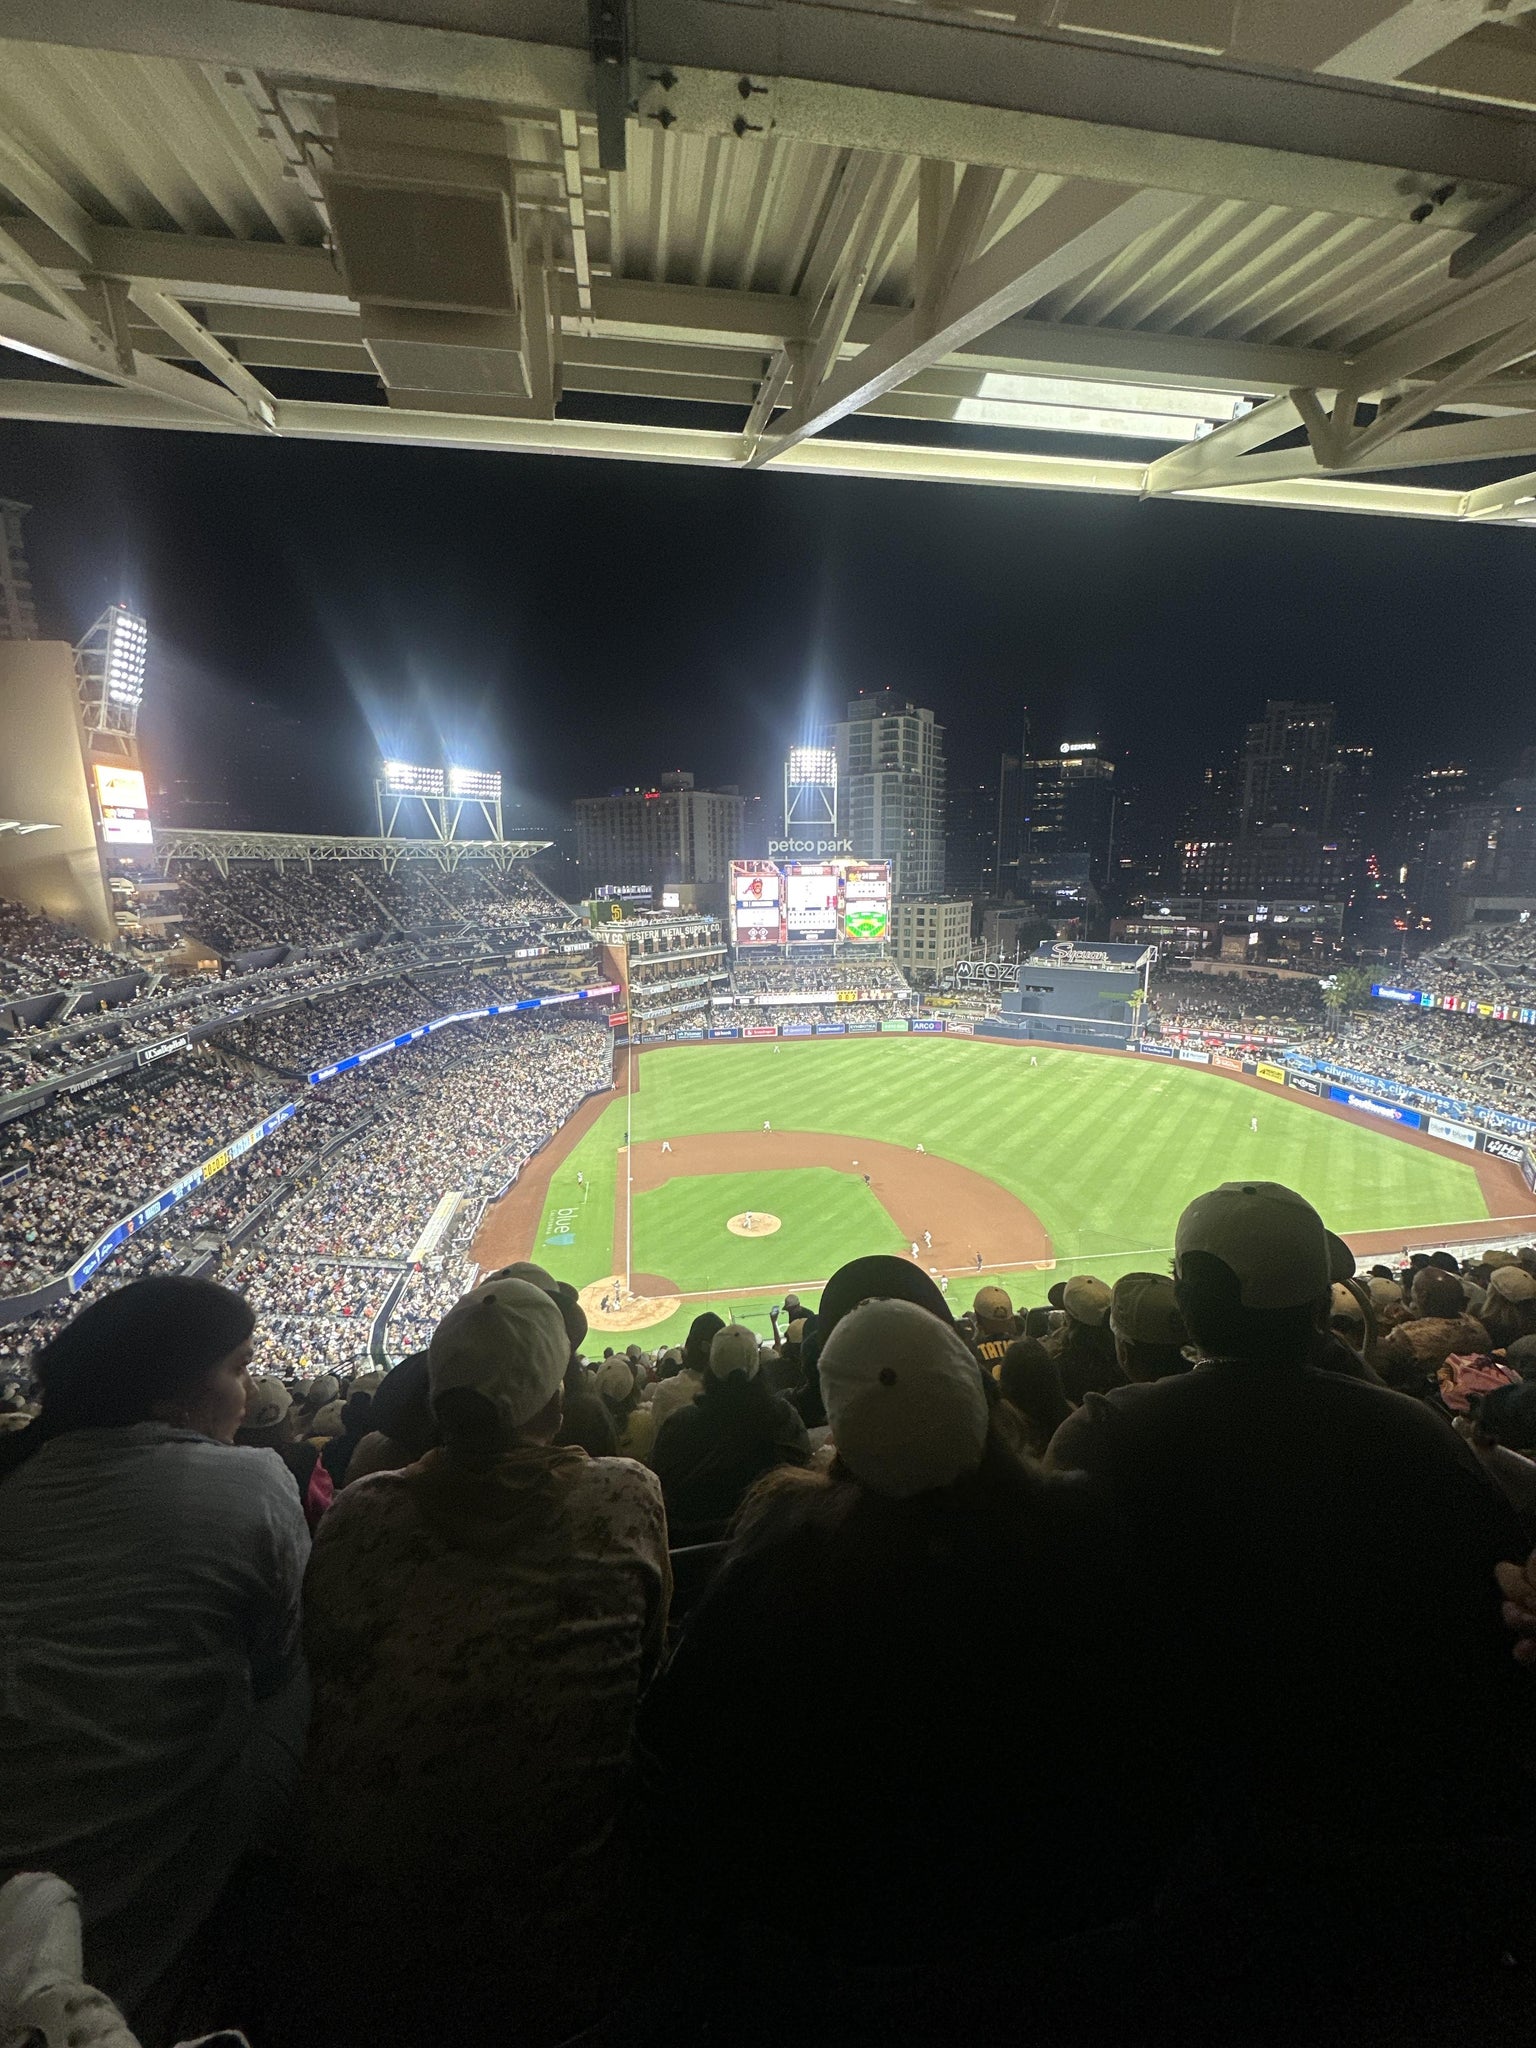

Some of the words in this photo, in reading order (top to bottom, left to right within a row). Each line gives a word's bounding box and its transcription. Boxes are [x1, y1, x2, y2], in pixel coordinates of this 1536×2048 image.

[768, 838, 814, 856] petco
[817, 838, 854, 855] park
[661, 925, 683, 938] METAL
[684, 922, 709, 935] SUPPLY
[1050, 942, 1110, 963] Sycuan
[914, 1022, 935, 1030] ARCO
[554, 1207, 579, 1234] blue
[977, 1339, 1015, 1360] TATI
